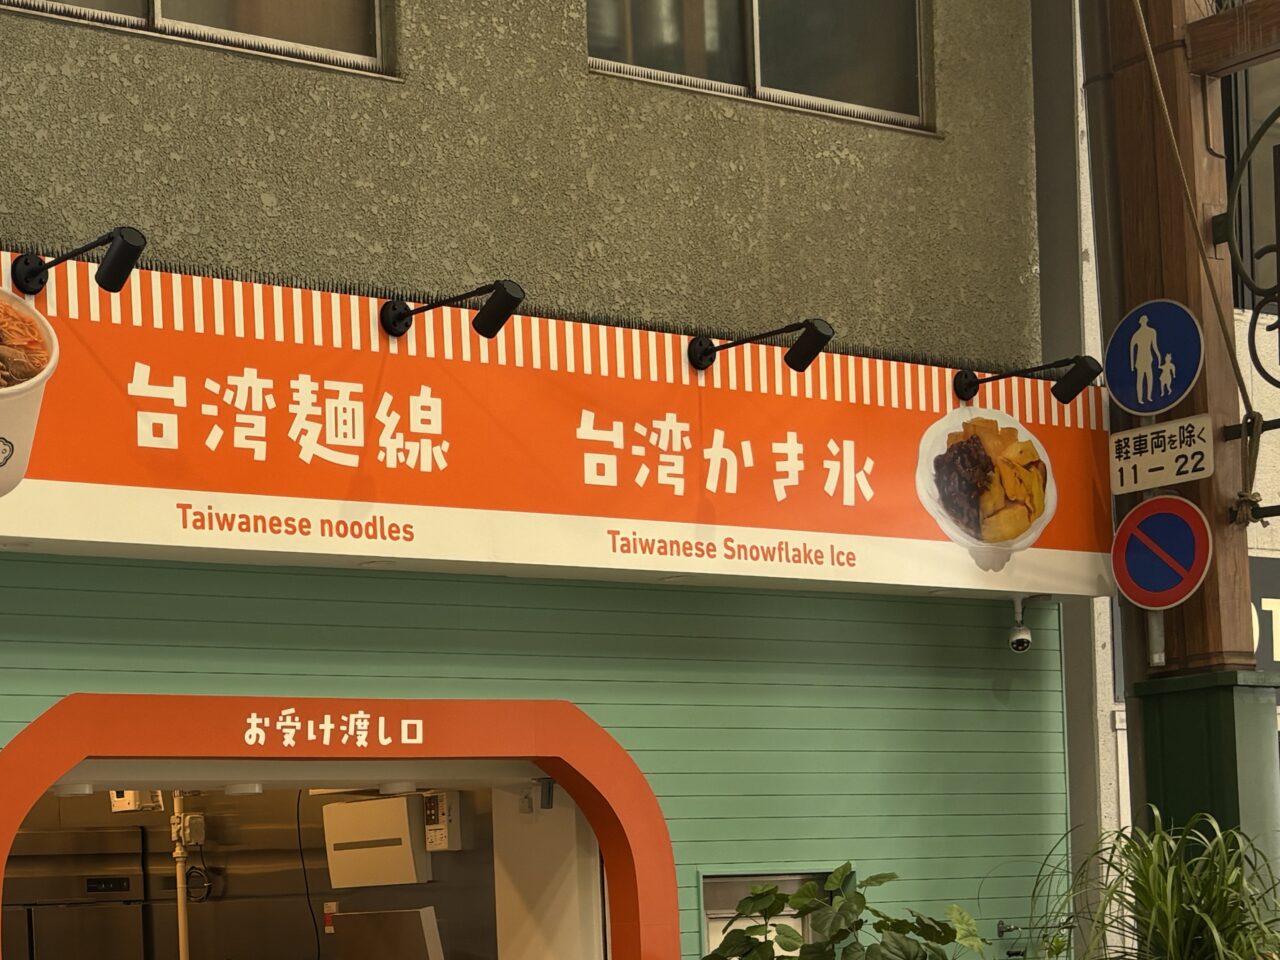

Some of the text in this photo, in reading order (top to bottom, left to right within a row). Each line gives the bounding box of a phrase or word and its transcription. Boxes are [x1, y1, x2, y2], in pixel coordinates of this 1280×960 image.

[576, 408, 875, 507] 台湾かき氷
[1114, 423, 1207, 462] 軽車両を除く
[176, 503, 415, 542] Taiwanese noodles
[608, 530, 856, 568] Taiwanese Snowflake Ice
[245, 707, 423, 748] お受け渡し口
